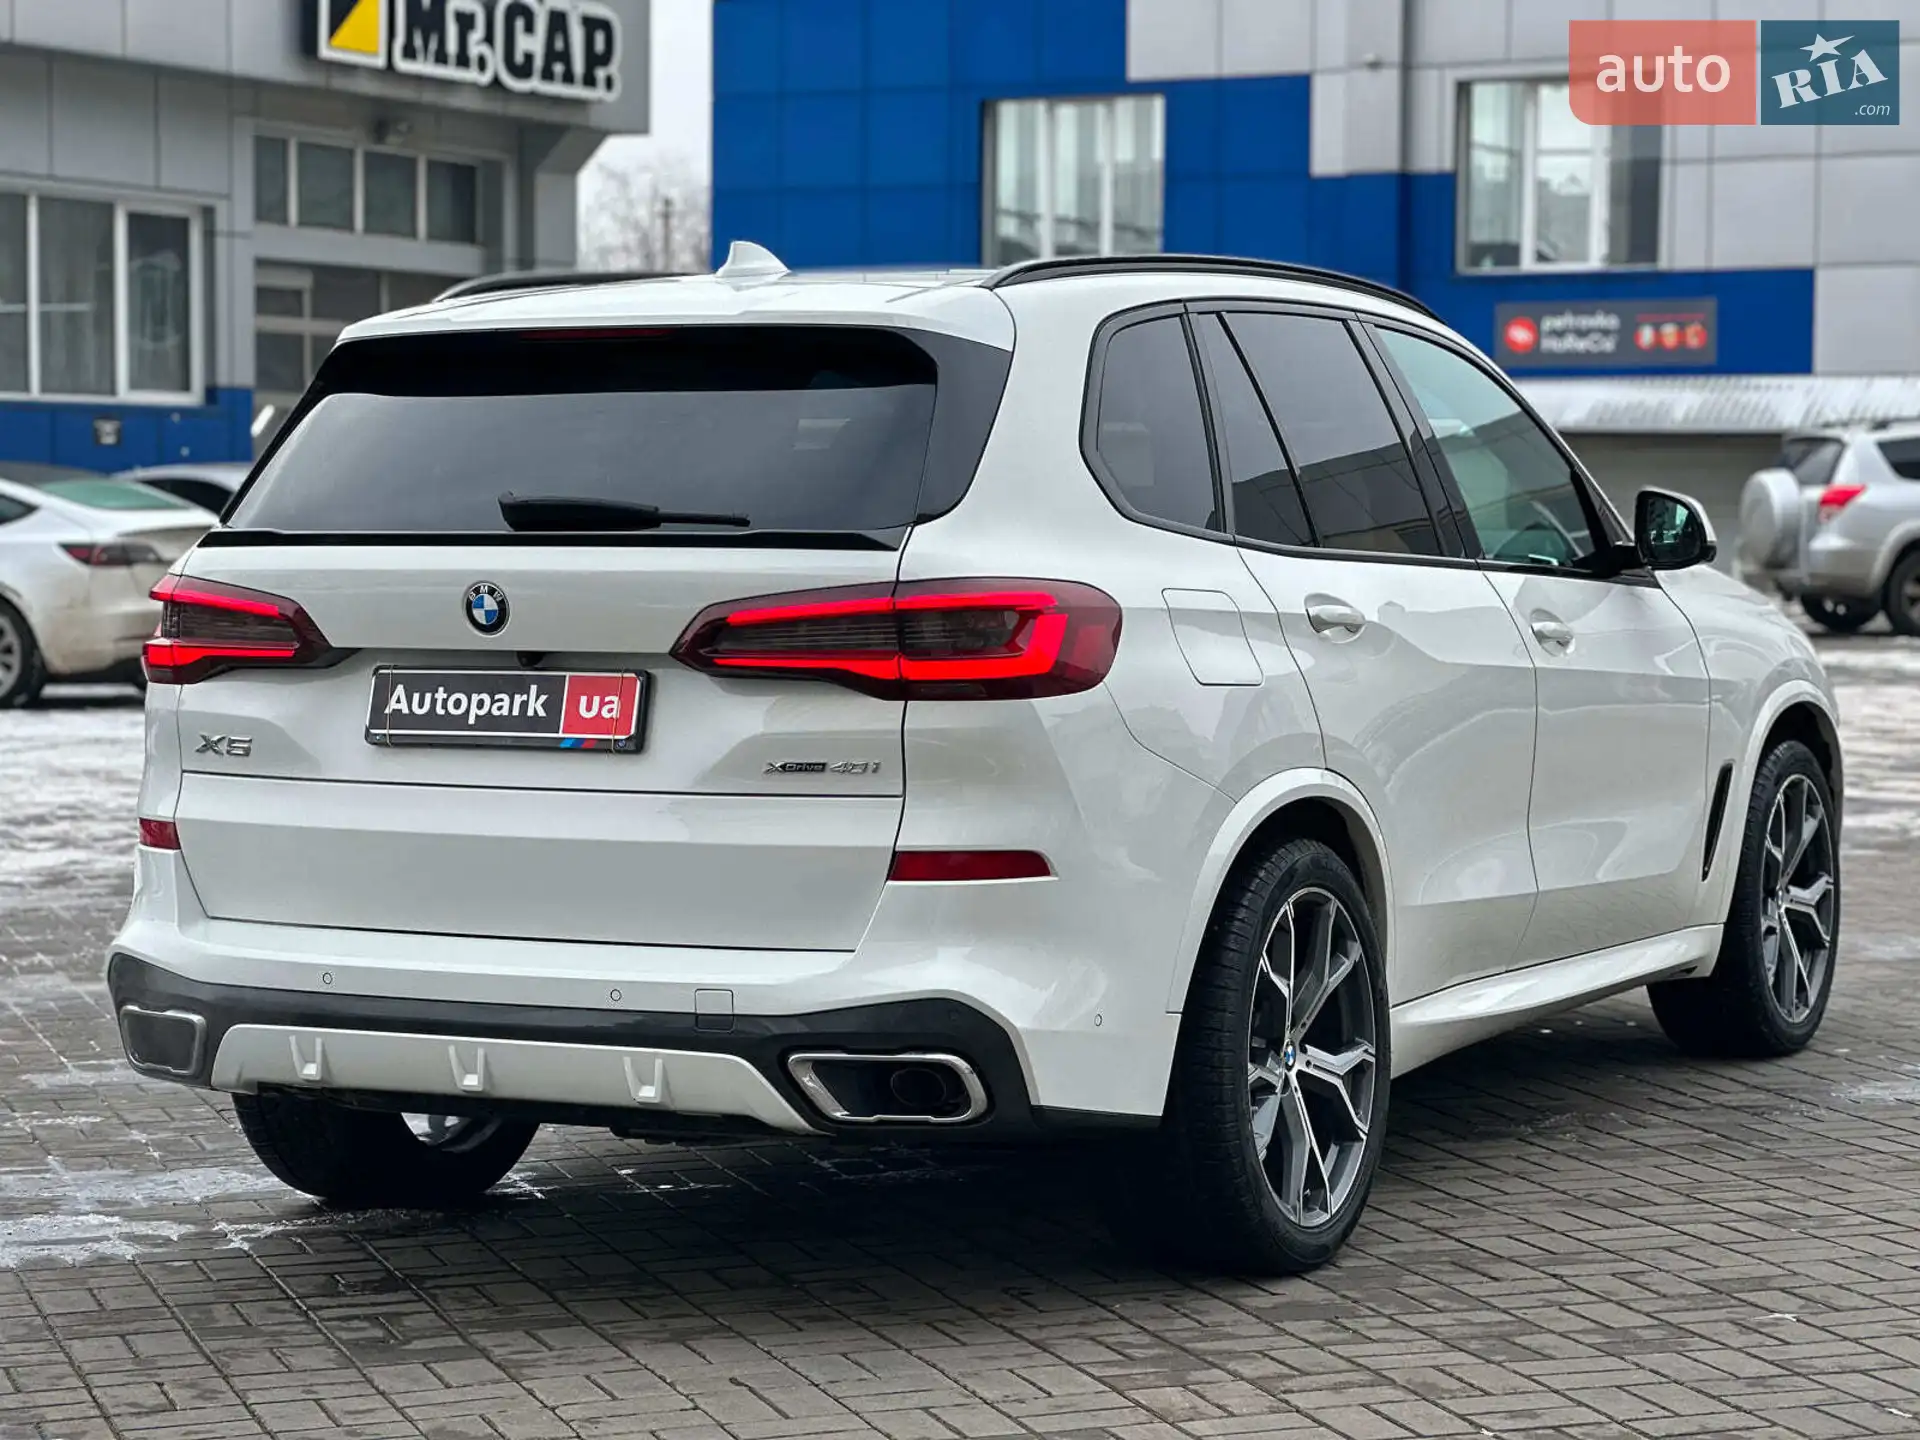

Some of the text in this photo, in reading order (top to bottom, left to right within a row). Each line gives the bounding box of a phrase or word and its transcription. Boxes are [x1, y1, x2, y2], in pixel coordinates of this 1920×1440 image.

[384, 684, 621, 725] Autopark ua
[195, 732, 253, 757] X5
